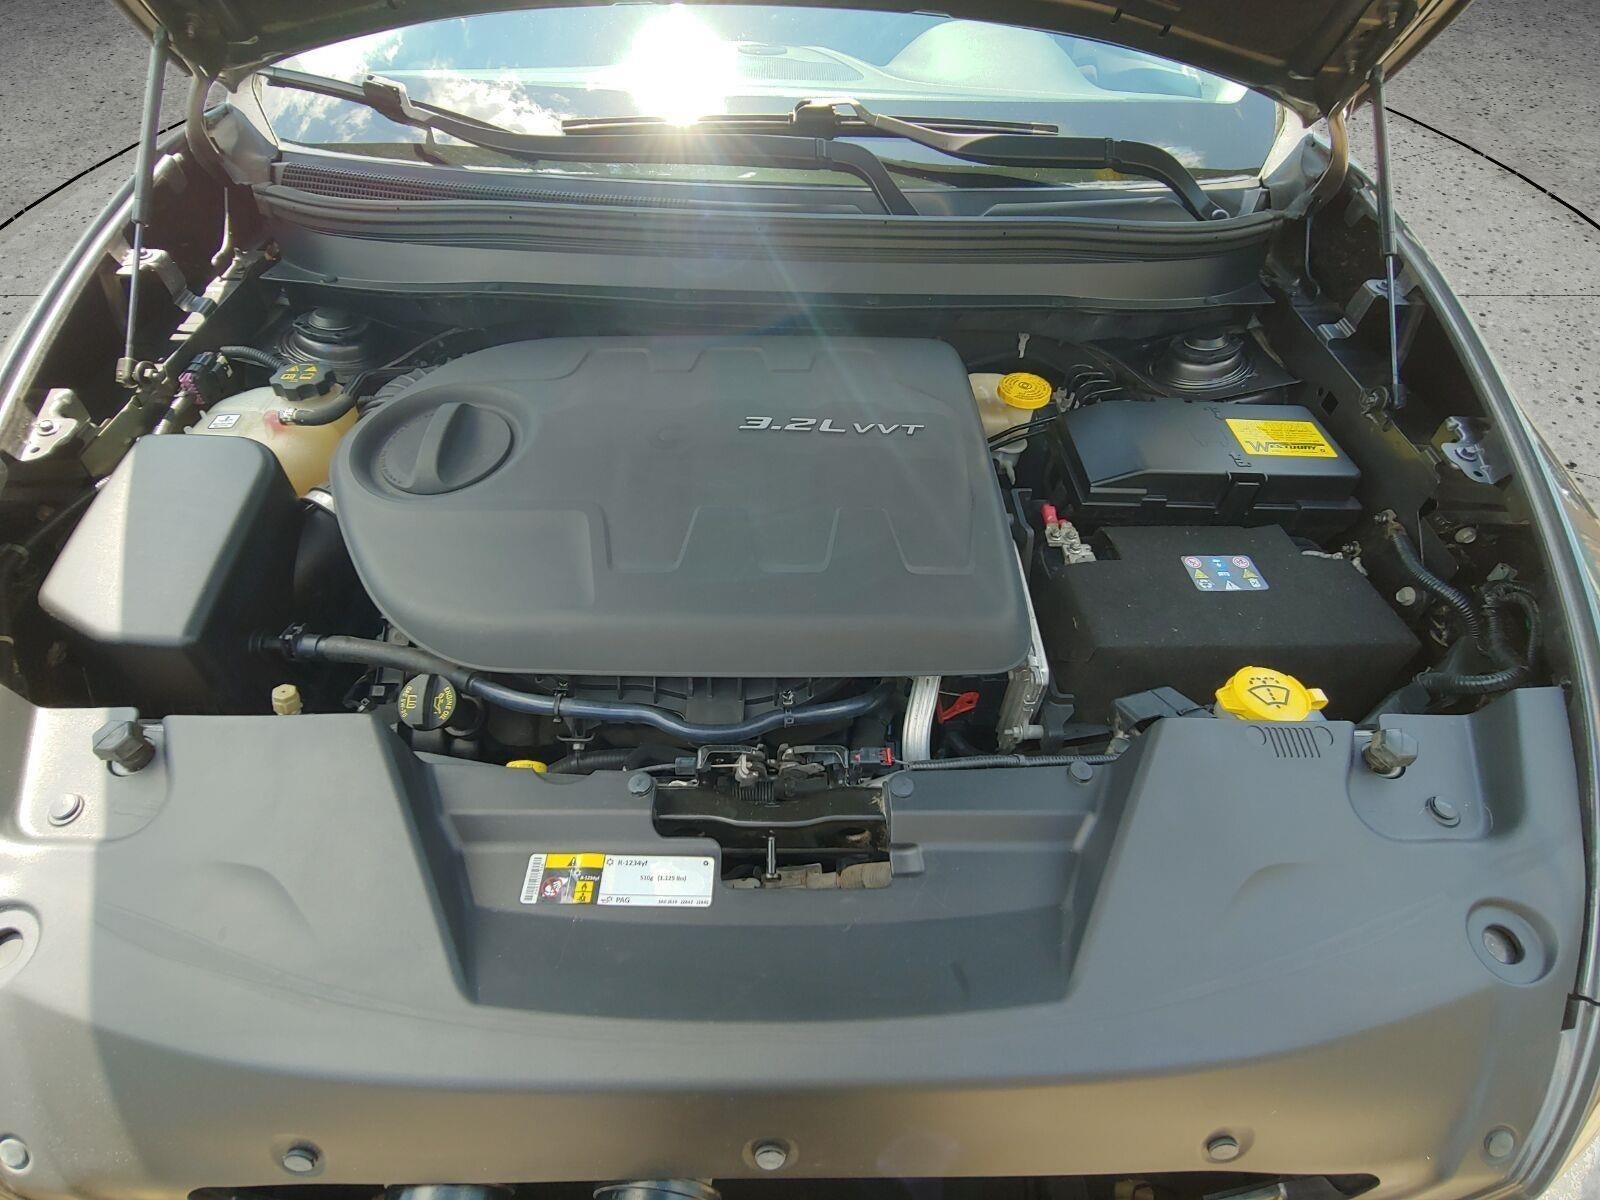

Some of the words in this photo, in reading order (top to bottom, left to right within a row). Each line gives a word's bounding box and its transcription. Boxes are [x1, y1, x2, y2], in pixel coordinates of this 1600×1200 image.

[738, 416, 847, 433] 3.2L
[852, 423, 925, 436] VVT
[443, 686, 454, 710] ENGINE
[438, 710, 450, 720] OIL
[617, 859, 648, 868] R-1234yf
[615, 896, 631, 904] PAG
